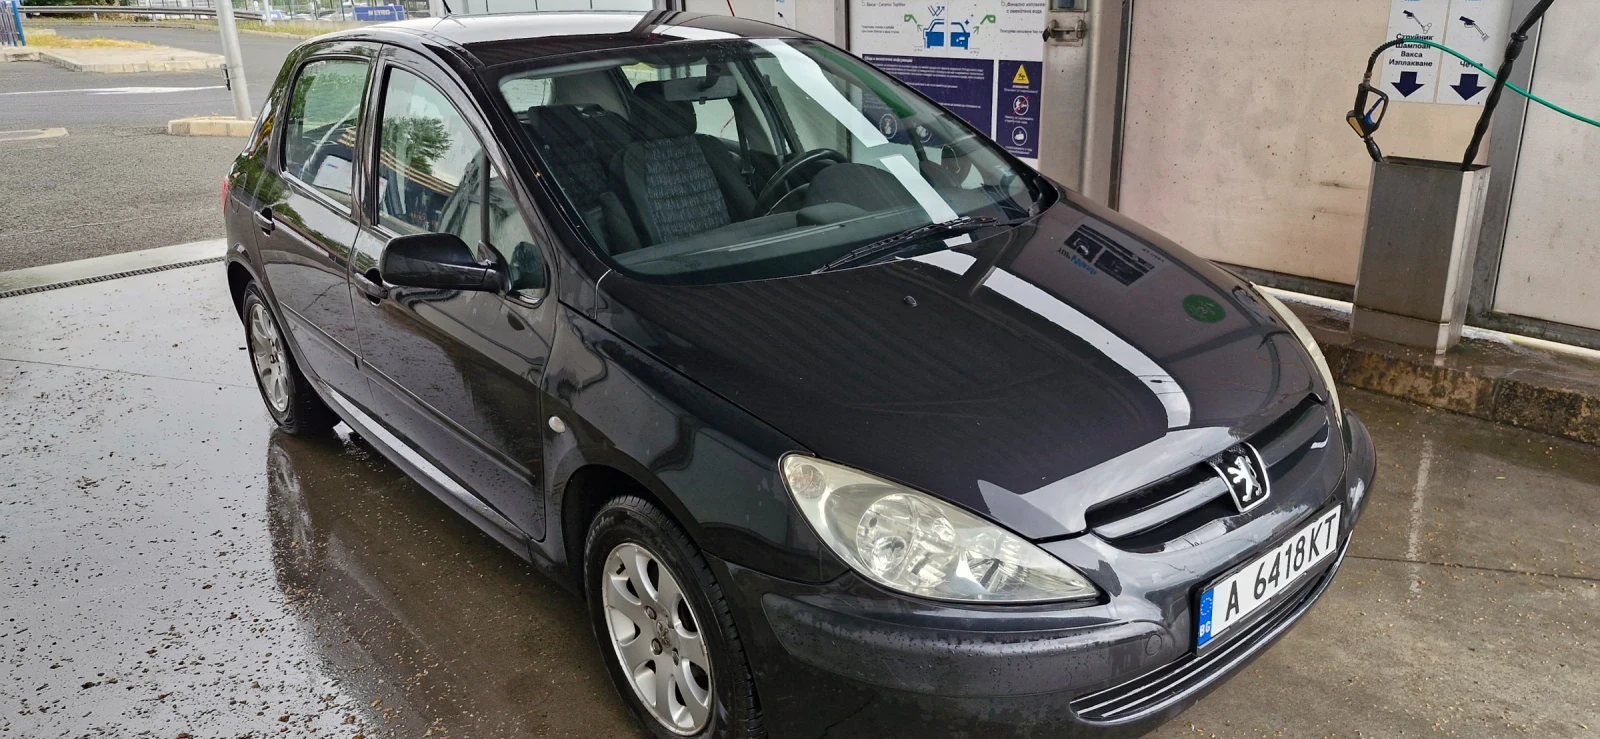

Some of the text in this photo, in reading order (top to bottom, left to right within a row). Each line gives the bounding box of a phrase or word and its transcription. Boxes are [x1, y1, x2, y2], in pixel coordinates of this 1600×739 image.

[1401, 50, 1423, 58] Вакса
[1389, 58, 1433, 67] Изплакване
[1225, 513, 1337, 622] A 6418KT
[1200, 621, 1211, 636] BG
